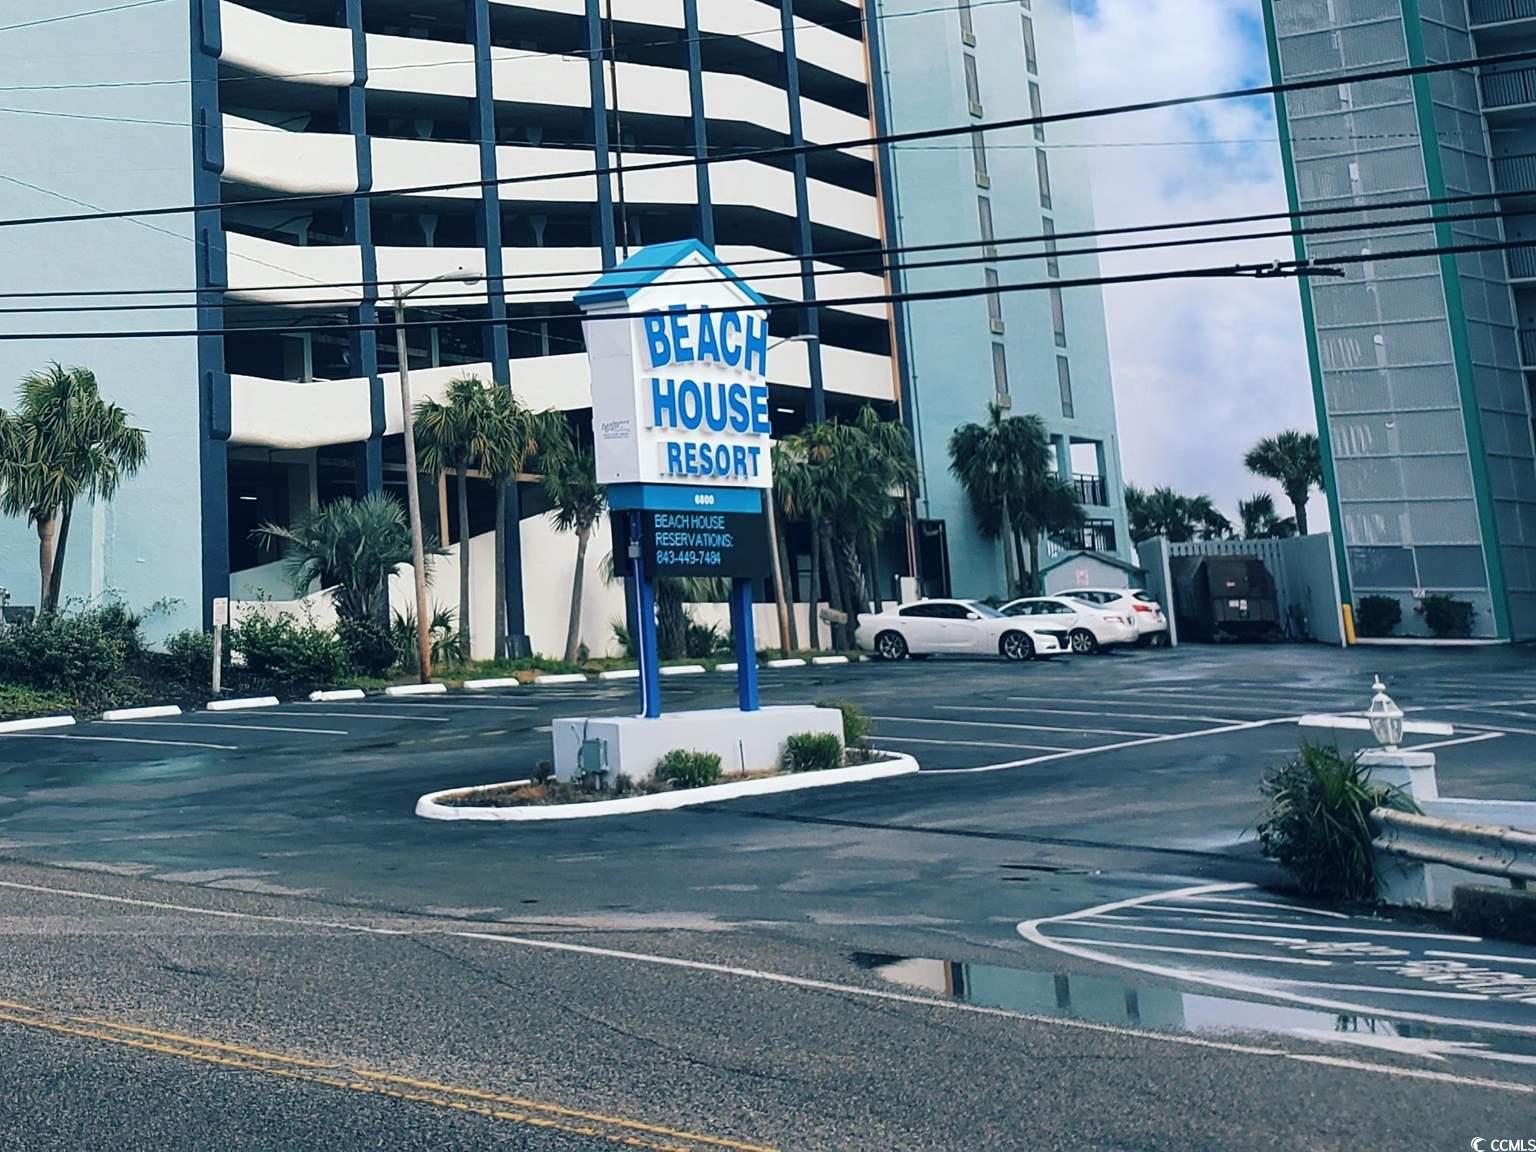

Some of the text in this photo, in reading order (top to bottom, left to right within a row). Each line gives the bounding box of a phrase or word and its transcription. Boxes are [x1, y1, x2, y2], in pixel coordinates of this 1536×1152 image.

[642, 303, 768, 377] BEACH
[651, 378, 771, 434] HOUSE
[667, 442, 761, 477] RESORT
[654, 514, 725, 530] BEACH HOUSE
[655, 533, 734, 548] RESERVATIONS:
[656, 550, 721, 565] 843-449-7484
